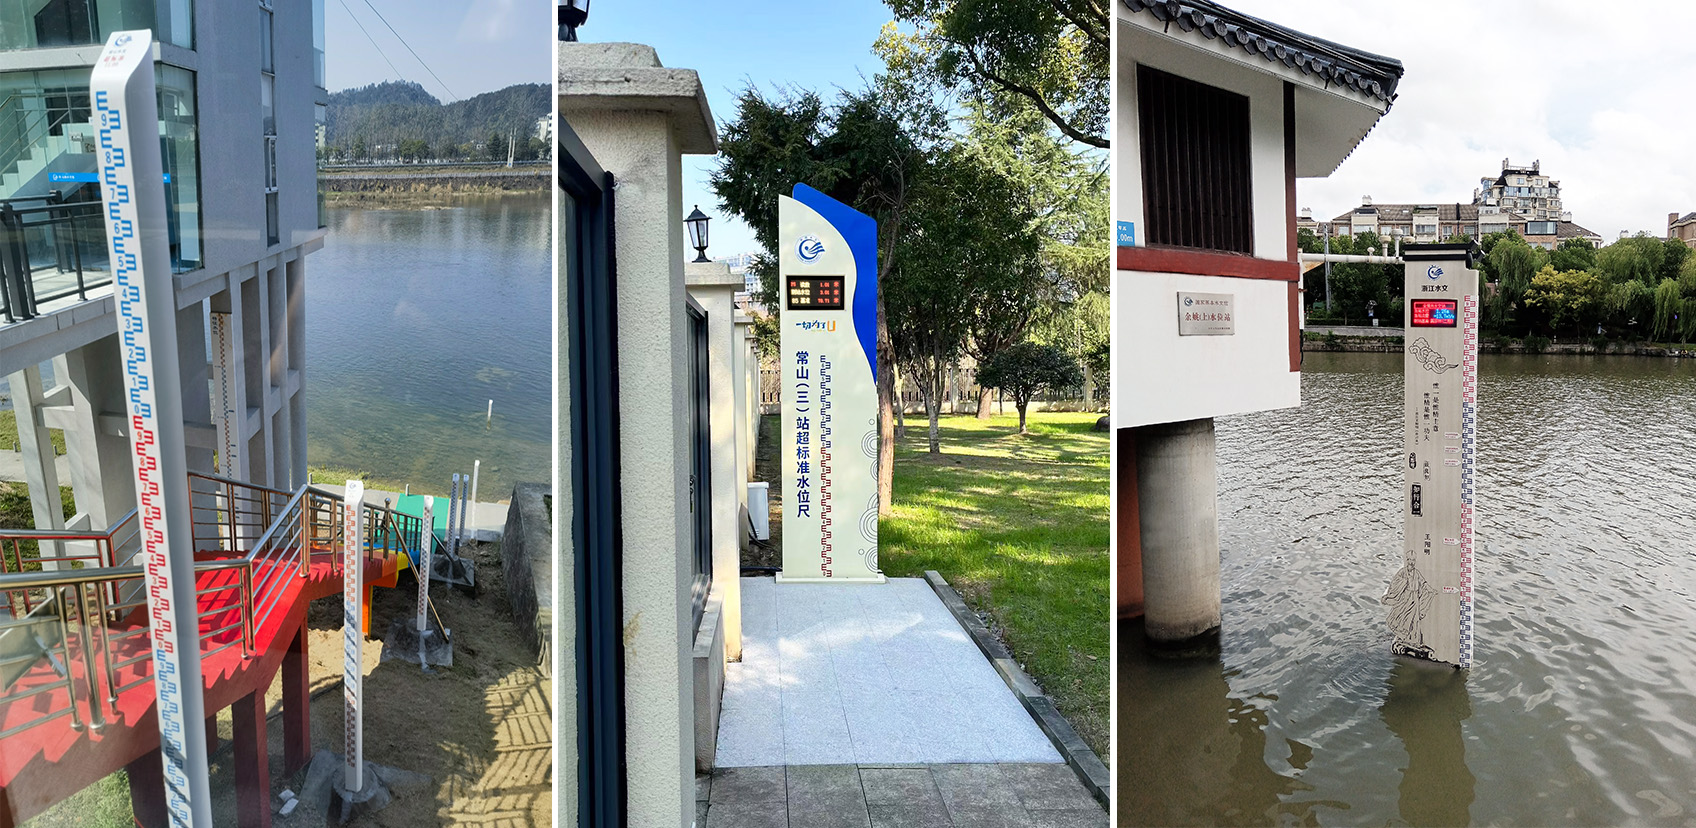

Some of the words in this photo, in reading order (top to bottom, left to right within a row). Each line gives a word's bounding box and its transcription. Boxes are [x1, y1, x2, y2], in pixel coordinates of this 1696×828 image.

[101, 113, 107, 126] 9
[105, 151, 111, 164] 8
[110, 188, 115, 200] 7
[114, 222, 120, 234] 6
[118, 256, 124, 268] 5
[122, 288, 127, 299] 4
[125, 319, 131, 329] 3
[128, 348, 134, 358] 2
[132, 377, 136, 386] 1
[134, 404, 140, 414] 0
[796, 350, 810, 518] 常山（三）站超标准水位尺
[142, 483, 147, 492] 7
